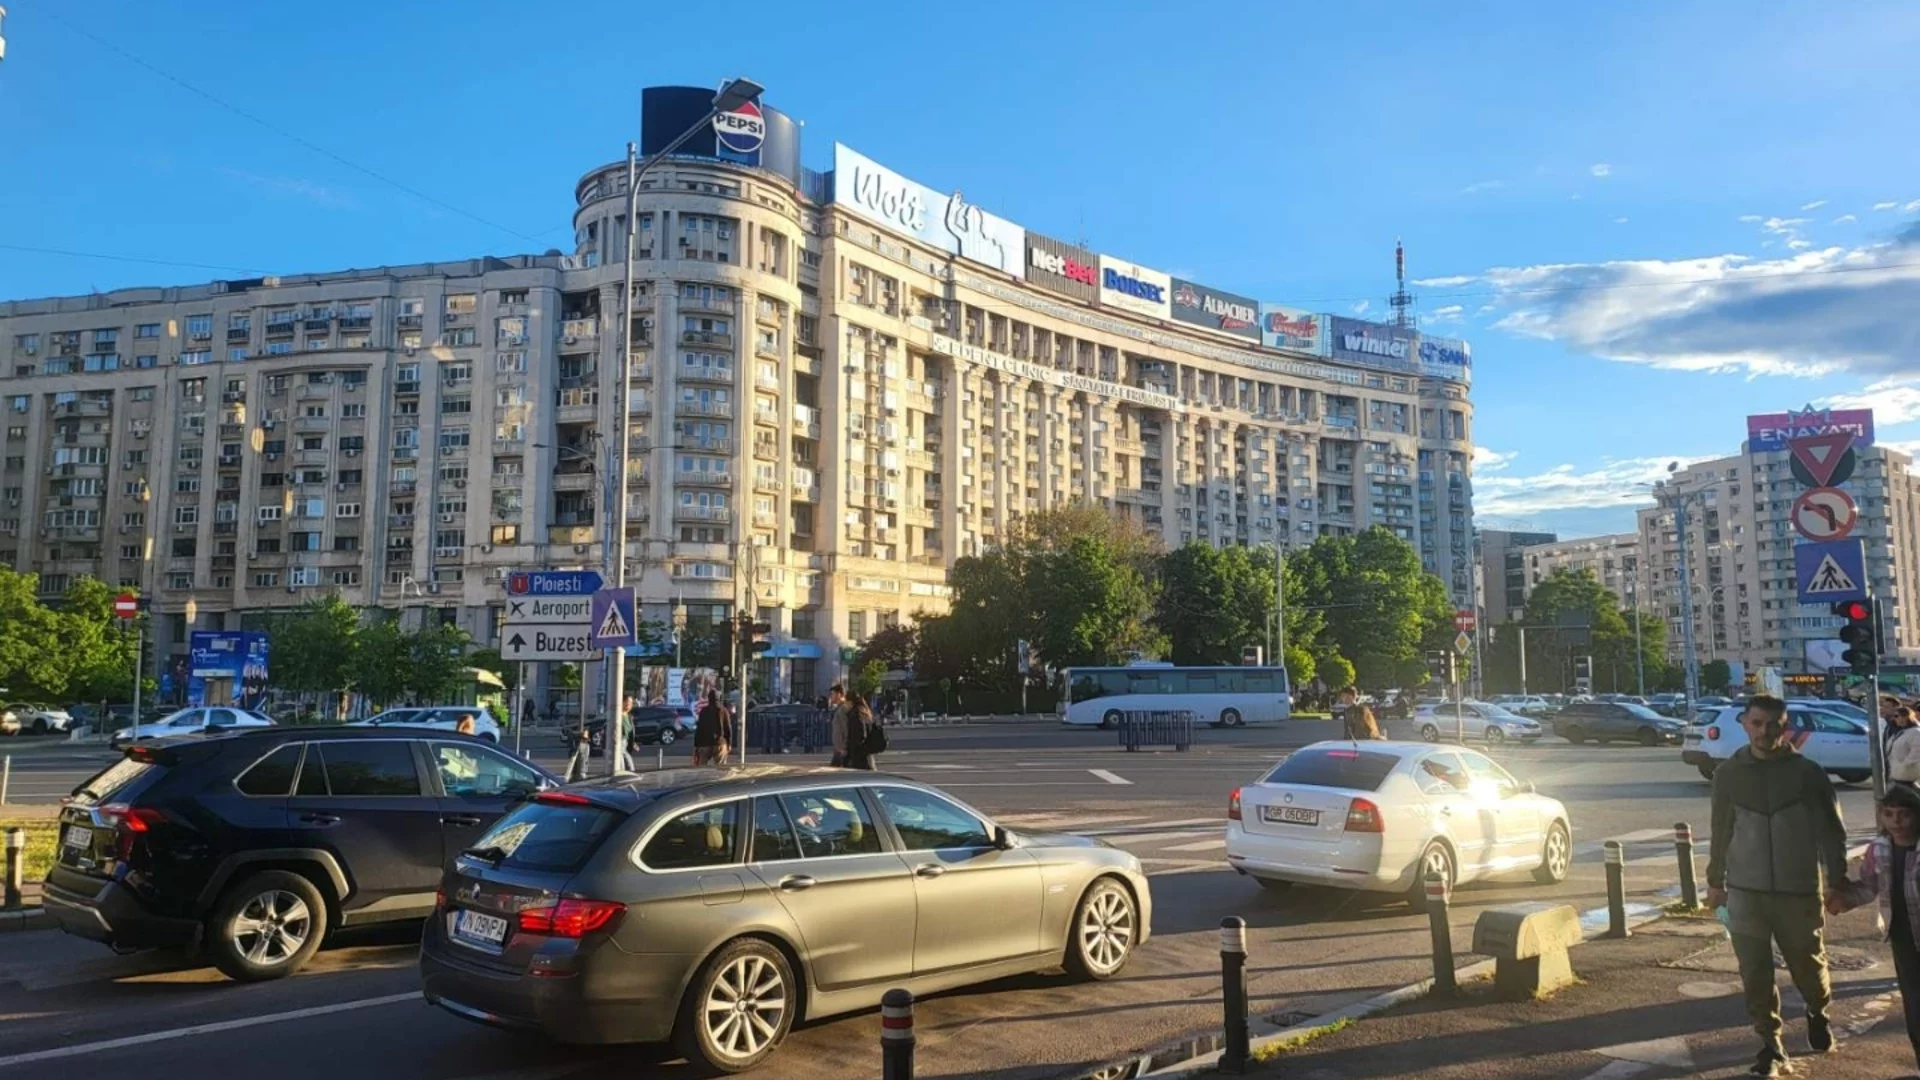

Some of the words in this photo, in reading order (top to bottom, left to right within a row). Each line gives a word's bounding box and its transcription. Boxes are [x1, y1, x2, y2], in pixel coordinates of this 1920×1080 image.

[715, 114, 763, 135] PEPSI
[854, 165, 927, 232] Wolt
[1030, 247, 1097, 285] NetBet
[1103, 267, 1166, 305] BORSEC
[1344, 328, 1407, 358] winner
[1759, 422, 1864, 442] ENAVATI
[532, 600, 590, 620] Aeroport
